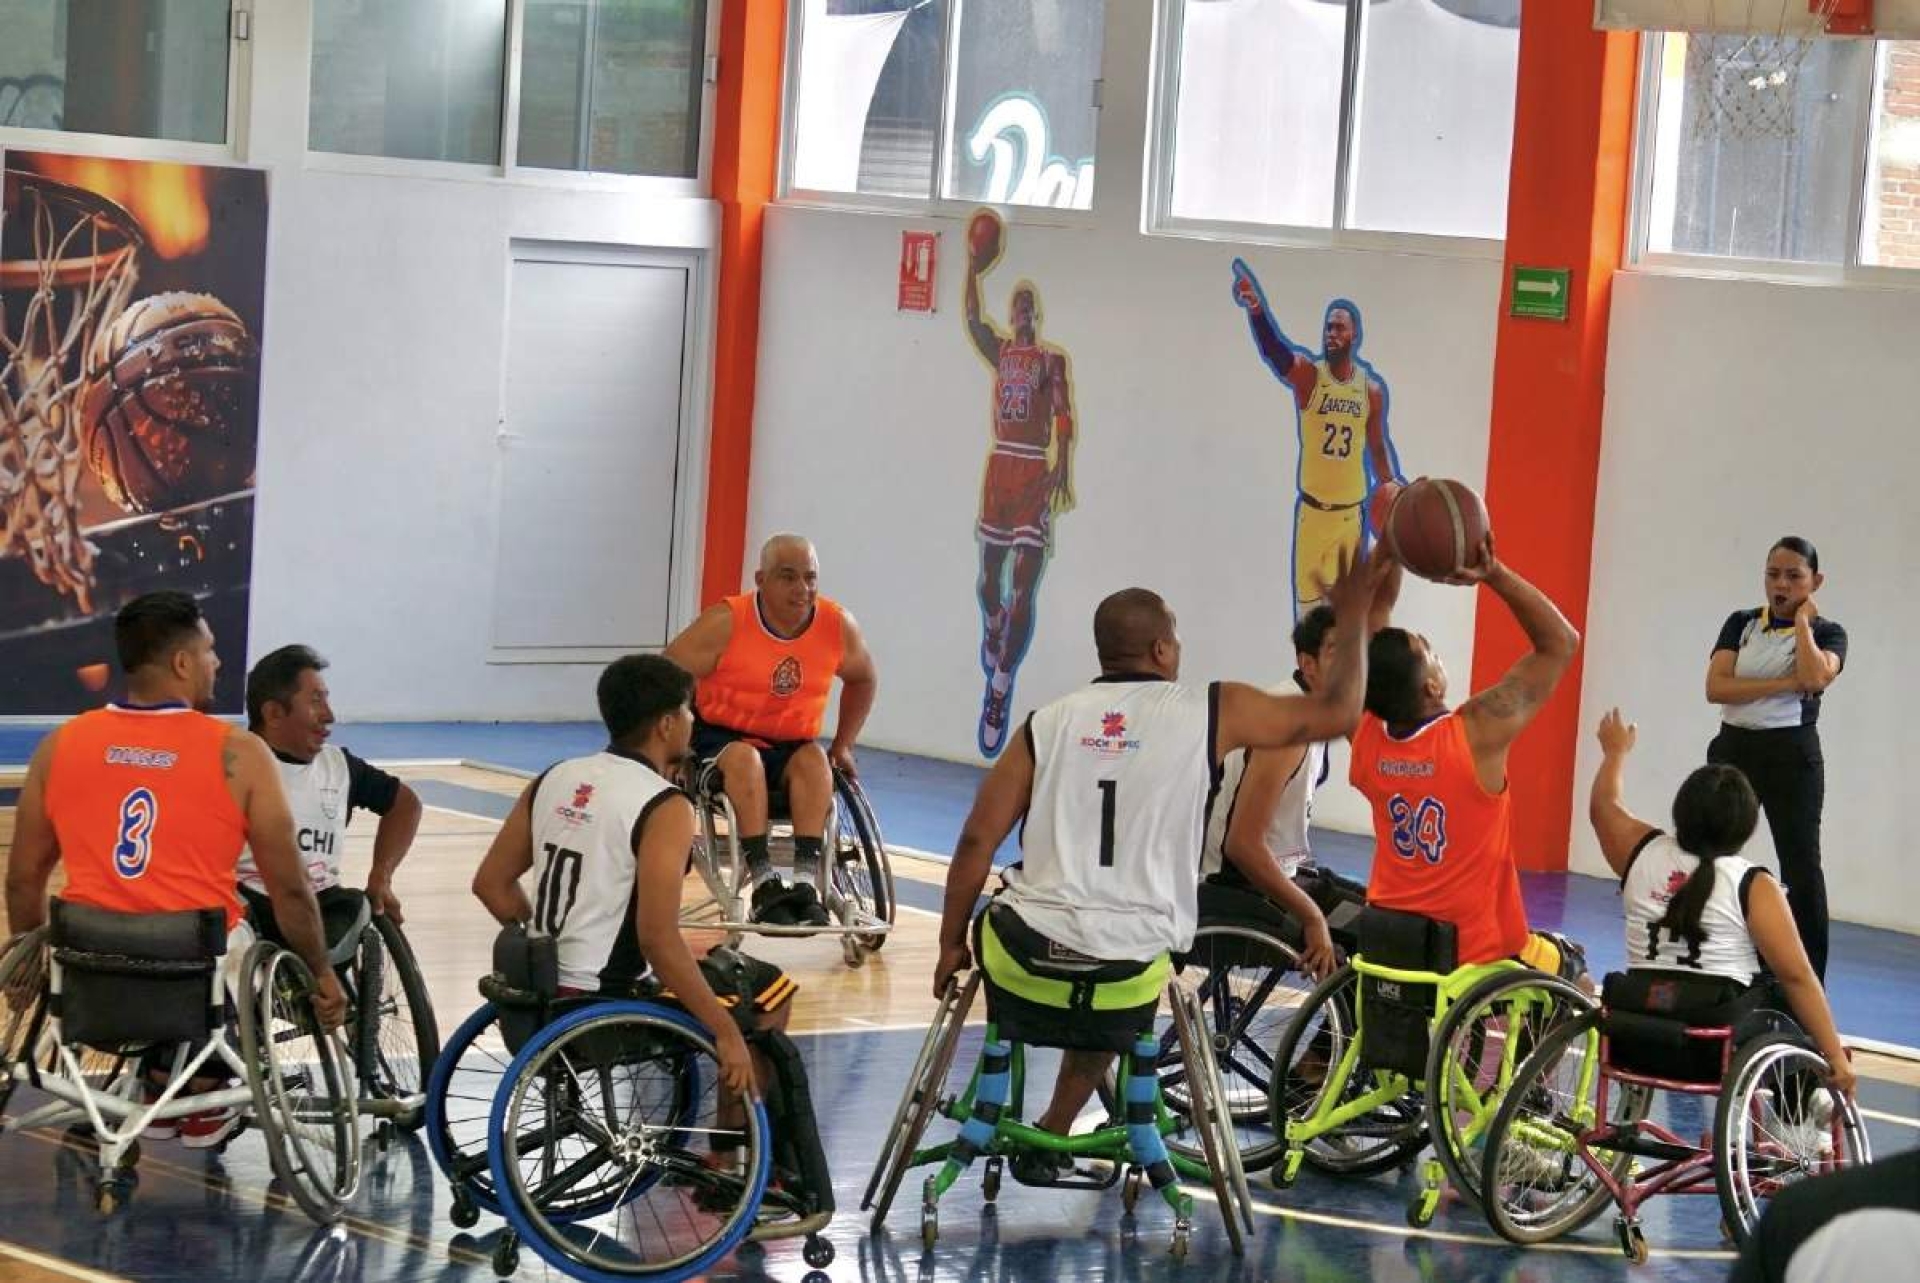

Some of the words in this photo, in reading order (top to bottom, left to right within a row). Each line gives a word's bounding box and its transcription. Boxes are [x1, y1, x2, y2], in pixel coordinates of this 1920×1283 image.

[1001, 384, 1031, 422] 23
[1317, 393, 1362, 418] LAKERS
[1322, 423, 1353, 458] 23
[113, 786, 158, 879] 3
[297, 827, 335, 855] CHI
[1097, 780, 1117, 867] 1
[1387, 793, 1447, 865] 34
[535, 841, 584, 939] 10
